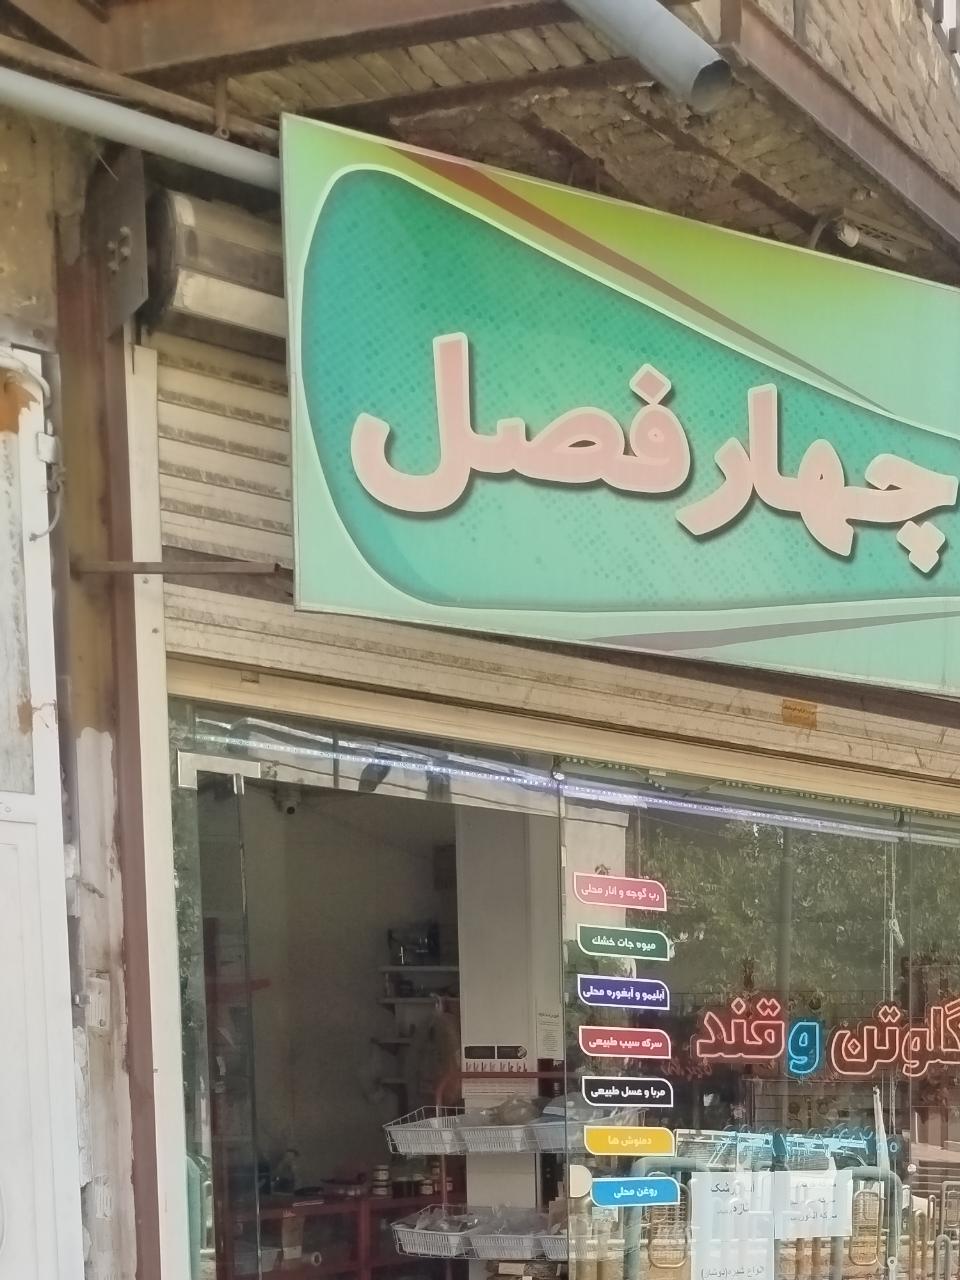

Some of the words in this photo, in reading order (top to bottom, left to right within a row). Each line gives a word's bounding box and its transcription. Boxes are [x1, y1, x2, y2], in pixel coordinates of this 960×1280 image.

[350, 331, 693, 514] فصل
[675, 384, 960, 574] چهار
[581, 883, 603, 896] محلی
[605, 885, 617, 897] انار
[618, 890, 624, 899] و
[626, 887, 647, 901] گوجه
[648, 889, 660, 902] رب
[617, 937, 634, 949] جات
[636, 939, 656, 951] میوه
[582, 985, 605, 998] محلی
[607, 986, 634, 999] آبغوره
[635, 991, 641, 1000] و
[642, 988, 665, 1001] آبلیمو
[696, 997, 786, 1060] قند
[588, 1036, 618, 1048] طبیعی
[619, 1039, 640, 1049] سیب
[642, 1038, 663, 1050] سرکه
[787, 1021, 822, 1076] و
[590, 1085, 620, 1098] طبیعی
[621, 1086, 643, 1098] عسل
[644, 1089, 649, 1098] و
[651, 1086, 666, 1098] مربا
[607, 1135, 619, 1145] ها
[621, 1135, 652, 1147] دمنوش
[613, 1186, 635, 1199] محلی
[636, 1187, 658, 1198] روغن
